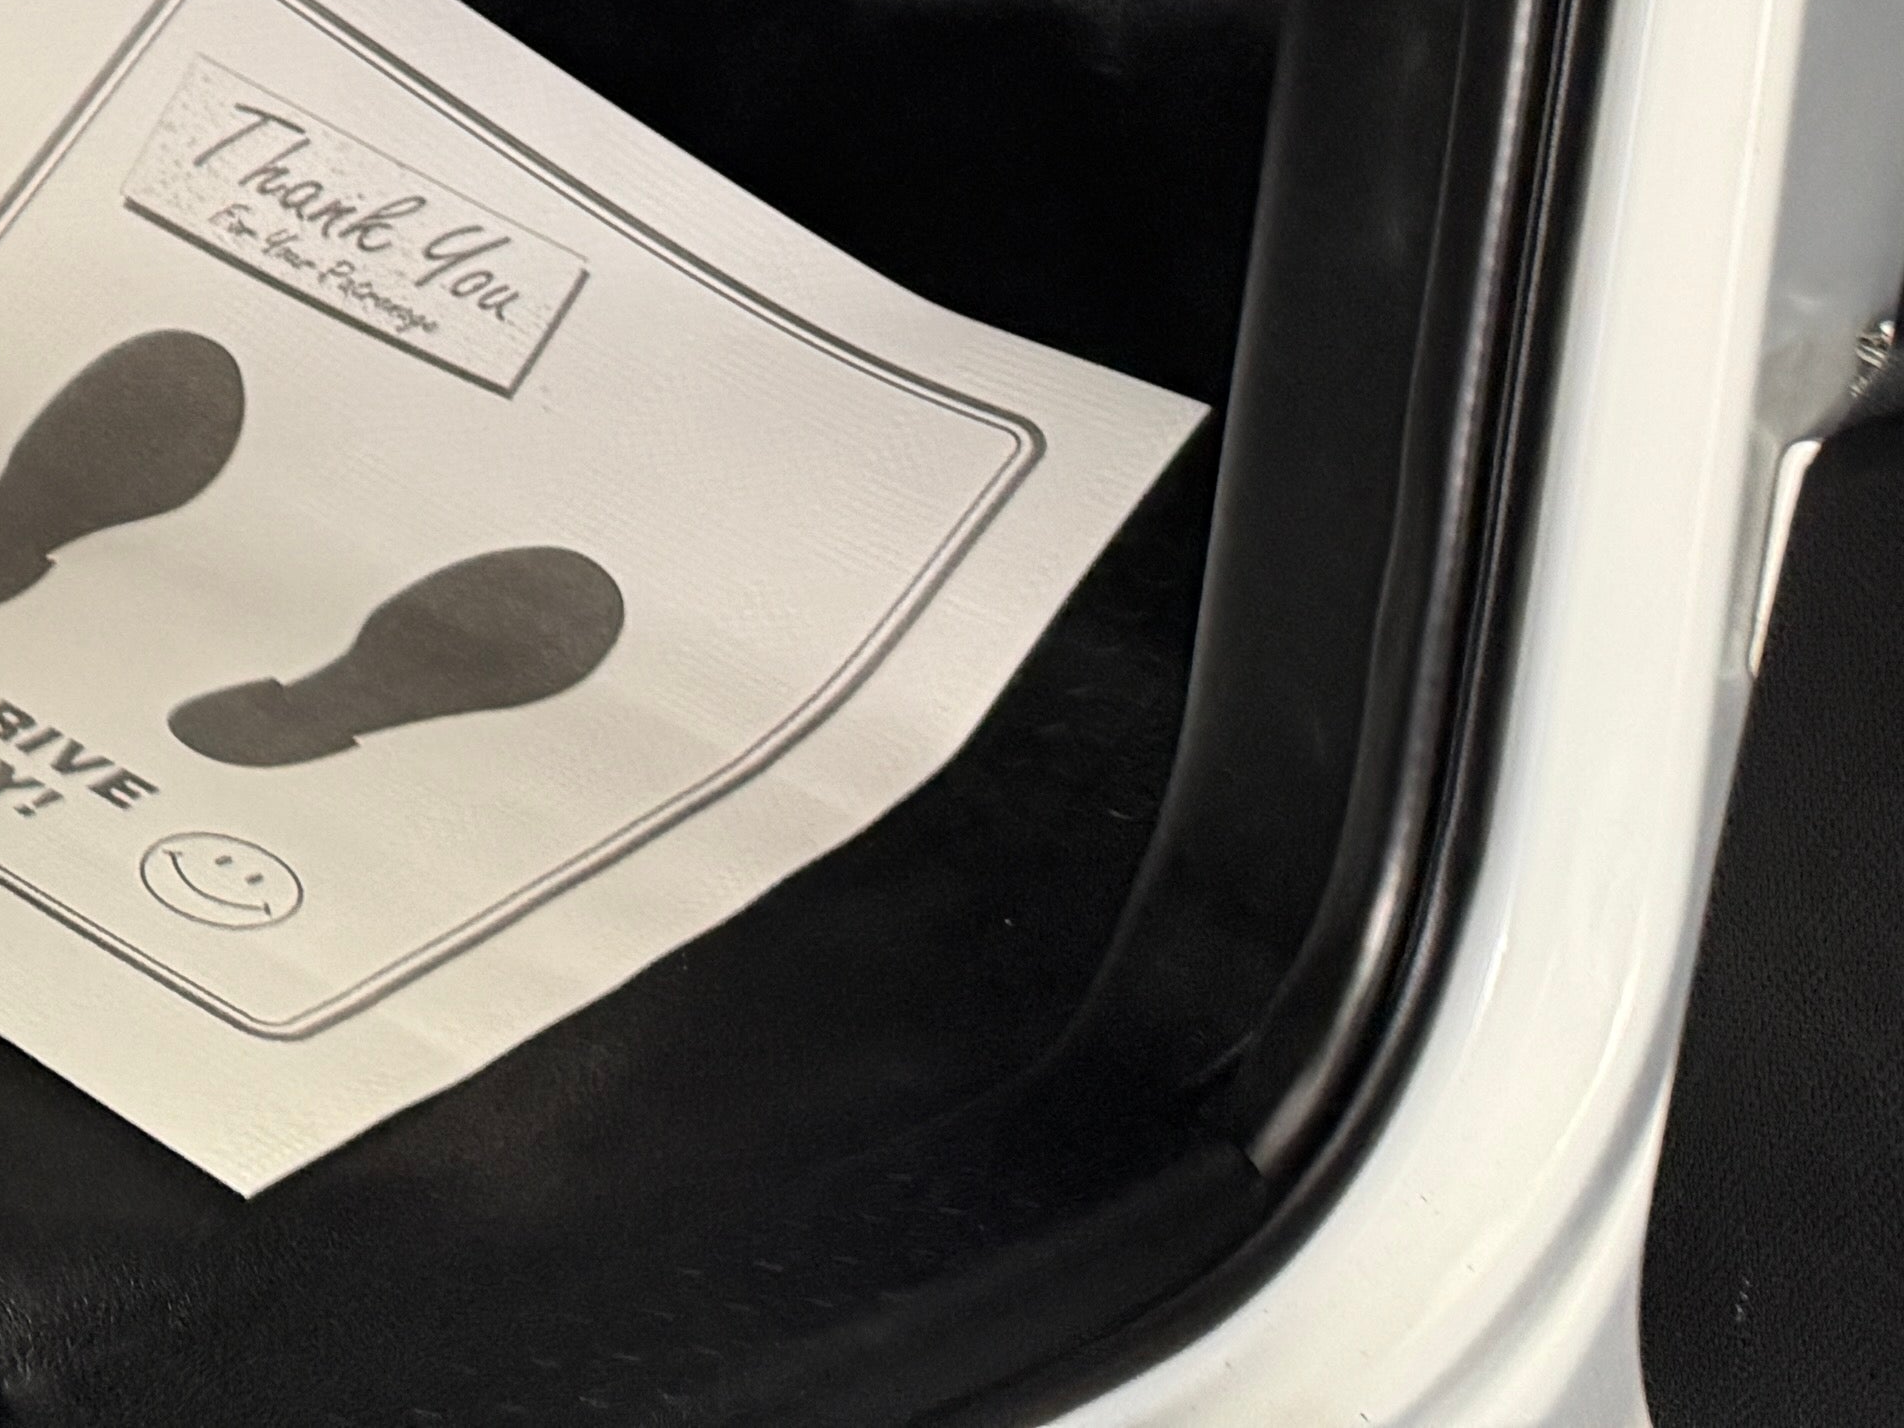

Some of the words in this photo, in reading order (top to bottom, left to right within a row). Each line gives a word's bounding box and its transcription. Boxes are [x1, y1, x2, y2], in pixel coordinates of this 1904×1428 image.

[194, 102, 428, 252] Thank
[414, 225, 520, 322] You
[208, 203, 258, 238] For
